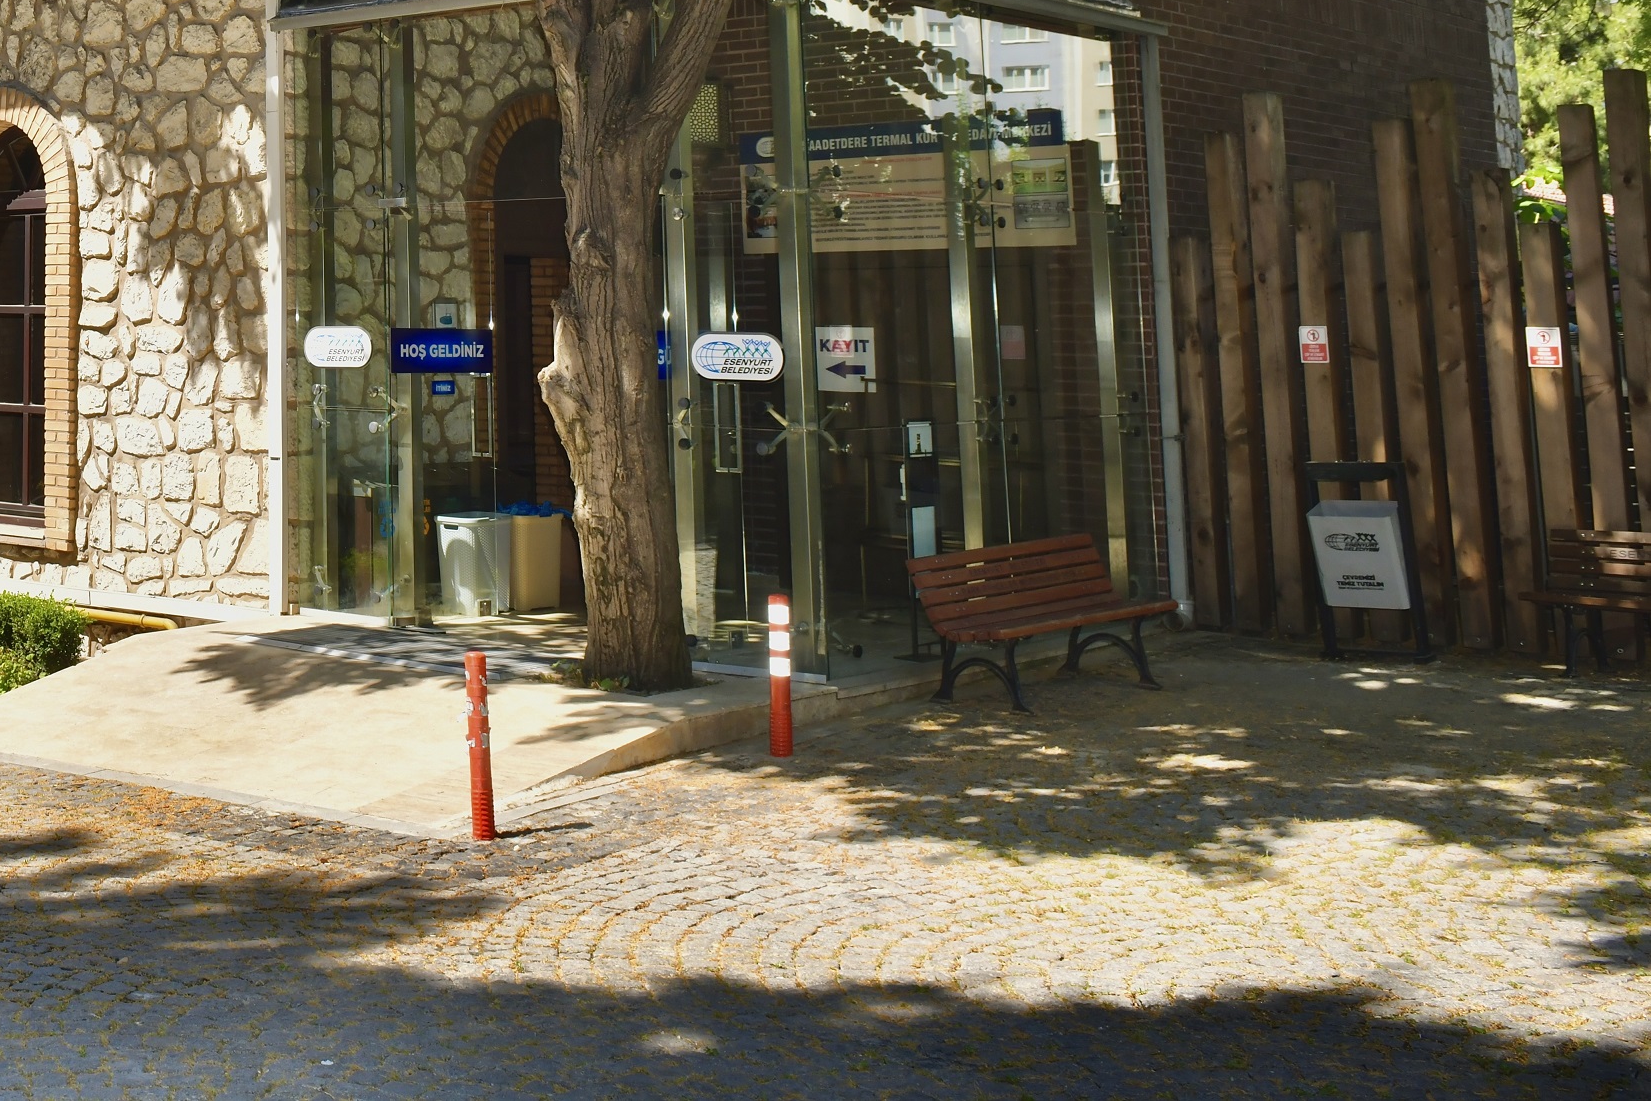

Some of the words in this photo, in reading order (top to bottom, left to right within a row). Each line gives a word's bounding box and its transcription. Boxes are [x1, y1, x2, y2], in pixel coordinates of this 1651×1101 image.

[807, 137, 867, 151] AADETDERE
[870, 135, 912, 147] TERMAL
[400, 344, 426, 360] HOŞ
[430, 341, 484, 358] GELDİNİZ
[819, 339, 870, 353] KAYIT
[723, 358, 773, 367] ESENYURT
[720, 366, 774, 375] BELEDİYESİ
